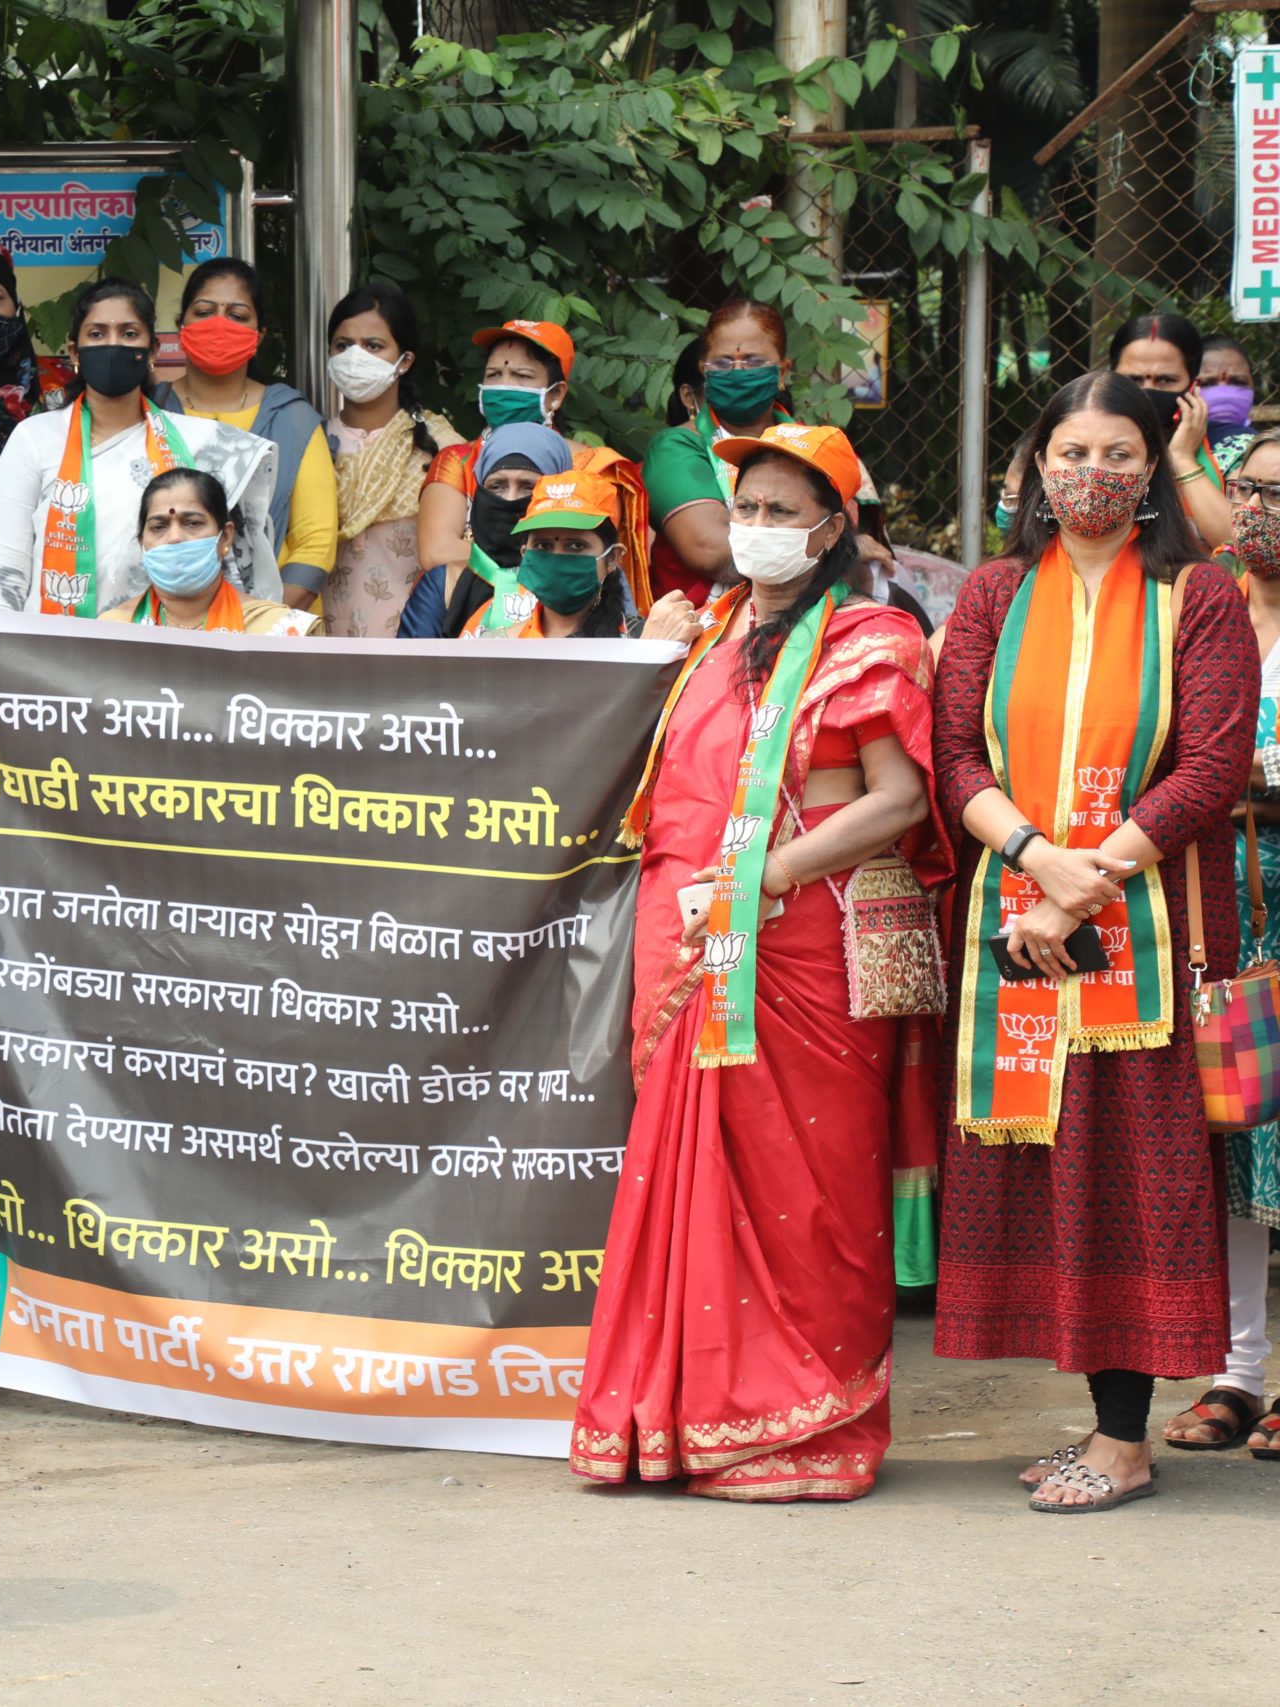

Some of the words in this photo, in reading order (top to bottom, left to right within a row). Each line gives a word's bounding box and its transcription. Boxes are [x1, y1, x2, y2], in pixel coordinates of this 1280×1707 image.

[1252, 108, 1280, 263] MEDICINE
[68, 229, 120, 254] अंतर्ग
[103, 688, 213, 743] असो...
[227, 694, 370, 751] धिक्कार
[380, 703, 496, 759] असो...
[89, 774, 280, 826] सरकारचा
[291, 774, 454, 839] धिक्कार
[466, 787, 598, 847] असो...
[54, 885, 160, 930] जनतेला
[168, 901, 276, 941] वाऱ्यावर
[284, 903, 362, 959] सोडून
[370, 911, 463, 960] बिळात
[132, 972, 263, 1016] सरकारचा
[270, 978, 382, 1028] धिक्कार
[391, 992, 490, 1034] असो...
[122, 1046, 226, 1087] करायचं
[234, 1058, 317, 1096] काय?
[326, 1064, 410, 1104] खाली
[419, 1065, 492, 1104] डोकं
[499, 1070, 533, 1102] वर
[66, 1104, 173, 1153] देण्यास
[183, 1124, 282, 1164] असमर्थ
[290, 1132, 420, 1174] ठरलेल्या
[429, 1136, 506, 1180] ठाकरे
[511, 1147, 627, 1180] सरकारच
[63, 1199, 229, 1269] धिक्कार
[239, 1219, 369, 1282] असो...
[385, 1229, 524, 1294] धिक्कार
[540, 1249, 605, 1293] अस
[8, 1286, 105, 1353] जनता
[115, 1315, 215, 1382] पार्टी,
[227, 1337, 322, 1388] उत्तर
[332, 1347, 479, 1397] रायगड
[489, 1345, 586, 1398] जिल
